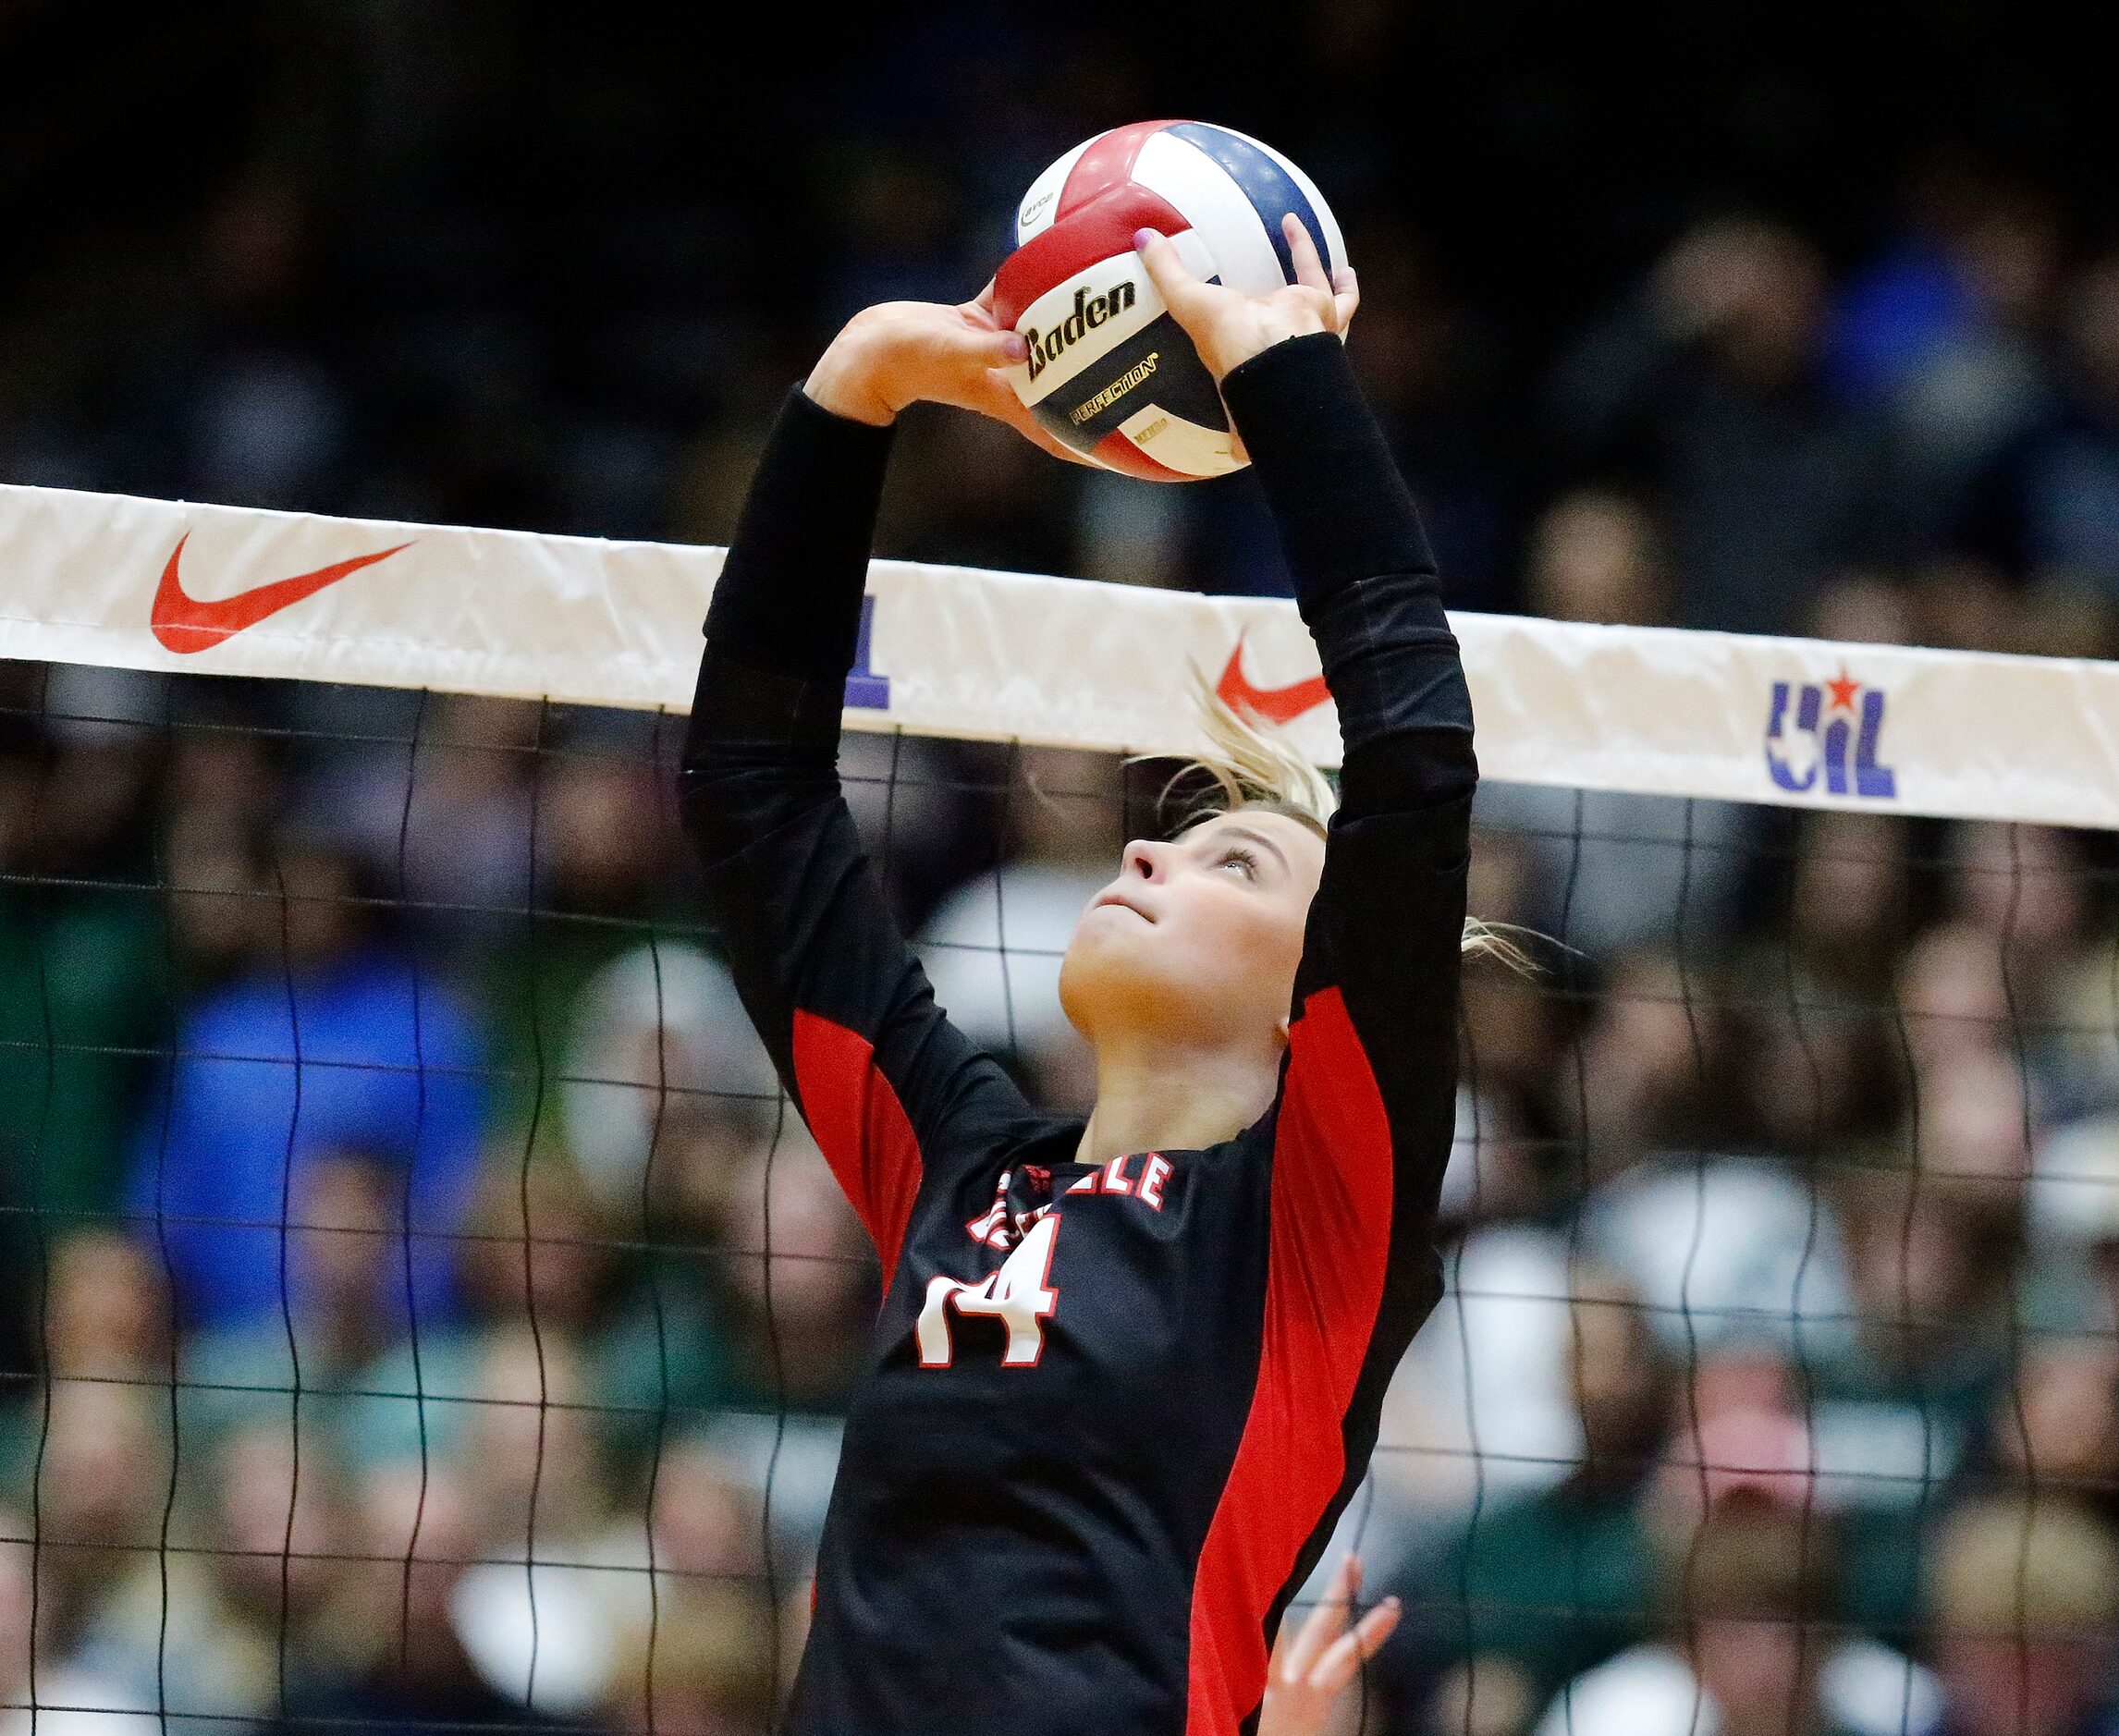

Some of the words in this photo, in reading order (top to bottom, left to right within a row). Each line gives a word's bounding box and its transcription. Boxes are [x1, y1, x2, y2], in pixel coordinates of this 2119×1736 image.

[1025, 280, 1136, 382] Baden
[1070, 353, 1158, 425] PERFECTION
[1767, 682, 1895, 797] UIL
